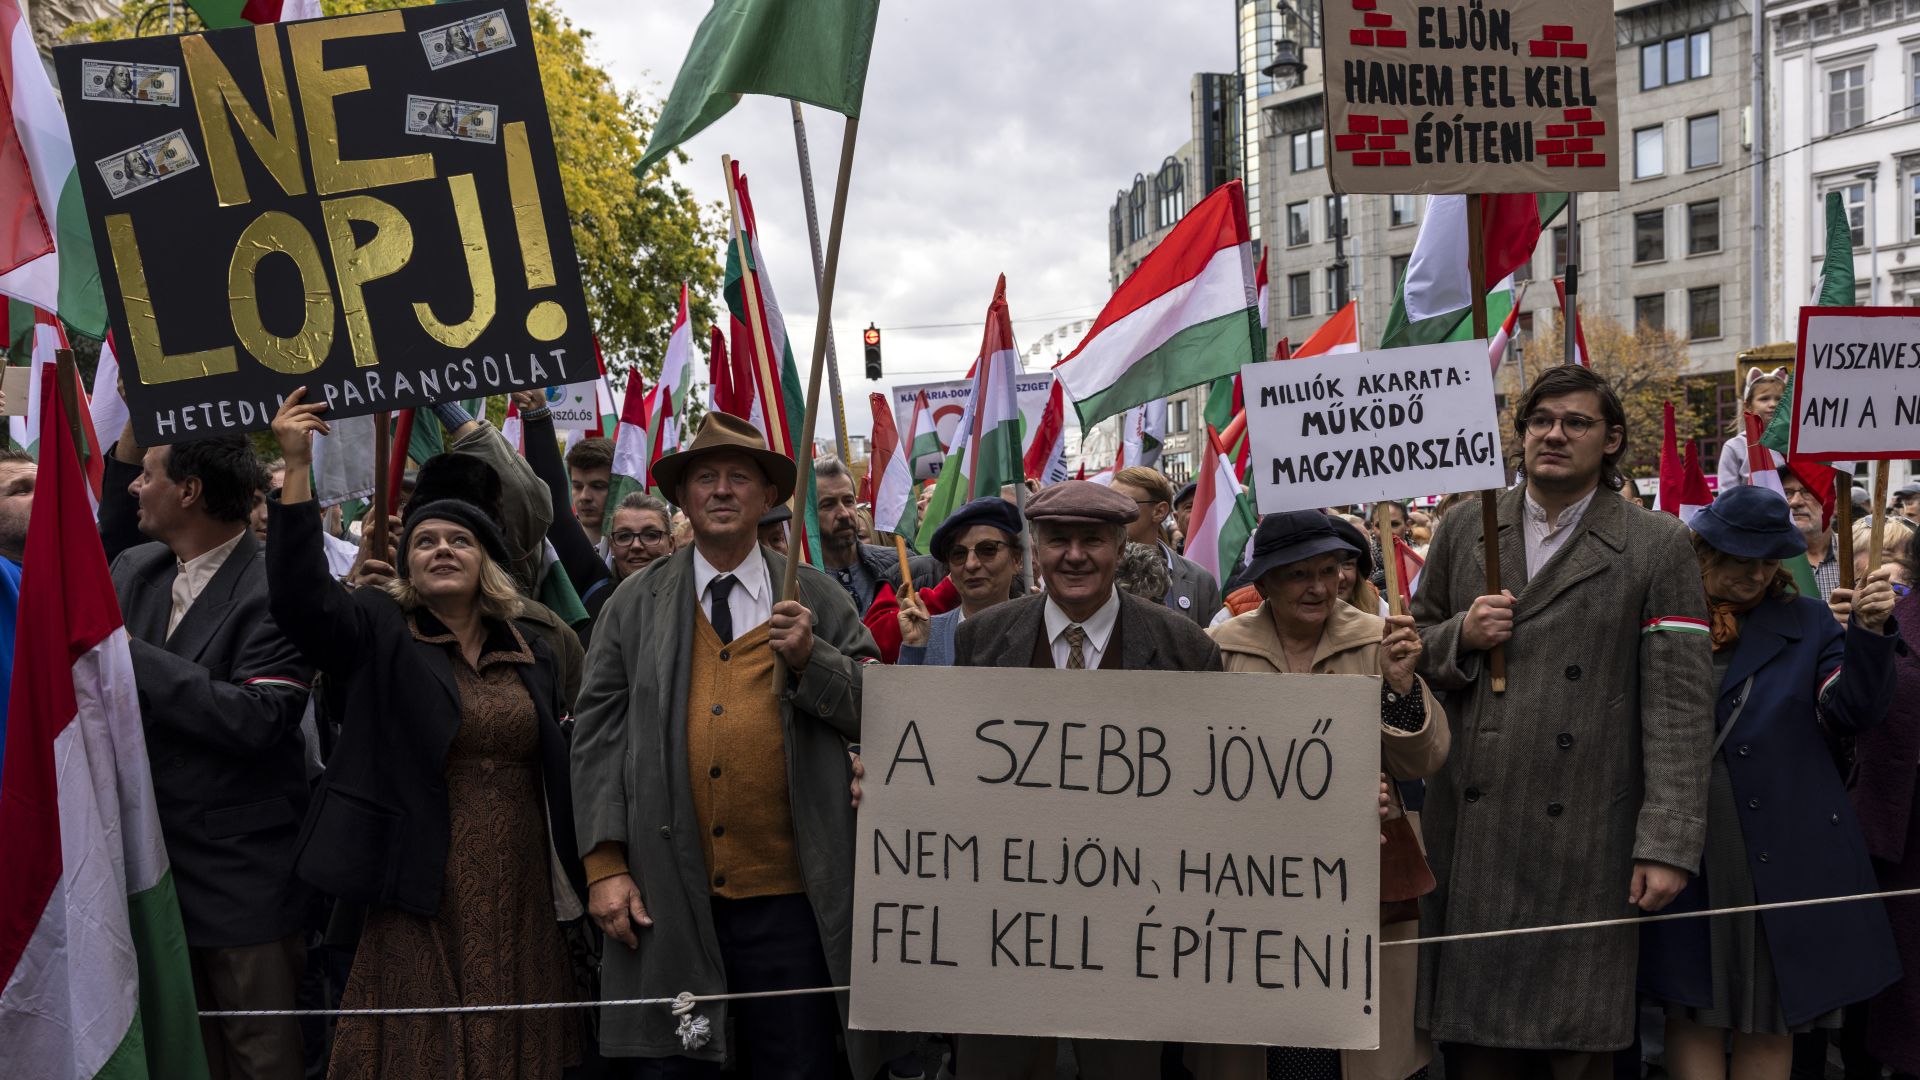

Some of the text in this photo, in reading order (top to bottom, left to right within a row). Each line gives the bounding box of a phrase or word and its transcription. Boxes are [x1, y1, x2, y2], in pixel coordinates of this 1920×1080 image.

[1418, 0, 1518, 56] ELJÖN,
[179, 10, 437, 207] NE
[1344, 60, 1597, 108] HANEM FEL KELL
[1415, 111, 1534, 164] ÉPÍTENI
[104, 120, 568, 385] LOPJ!
[1813, 342, 1920, 370] VISSZAVES
[157, 348, 568, 436] HETEDI PARANCSOLAT
[551, 409, 592, 421] NSZŐLŐS
[1260, 367, 1471, 408] MILLIÓK AKARATA:
[1302, 393, 1424, 437] MŰKÖDŐ
[1803, 397, 1849, 428] AMI
[1858, 396, 1877, 428] A
[1271, 428, 1495, 485] MAGYARORSZÁG!
[885, 718, 1333, 802] A SZEBB JÖVŐ
[874, 829, 1348, 904] NEM ELJÖN, HANEM
[872, 902, 1372, 1015] FEL KELL ÉPÍTENI!
